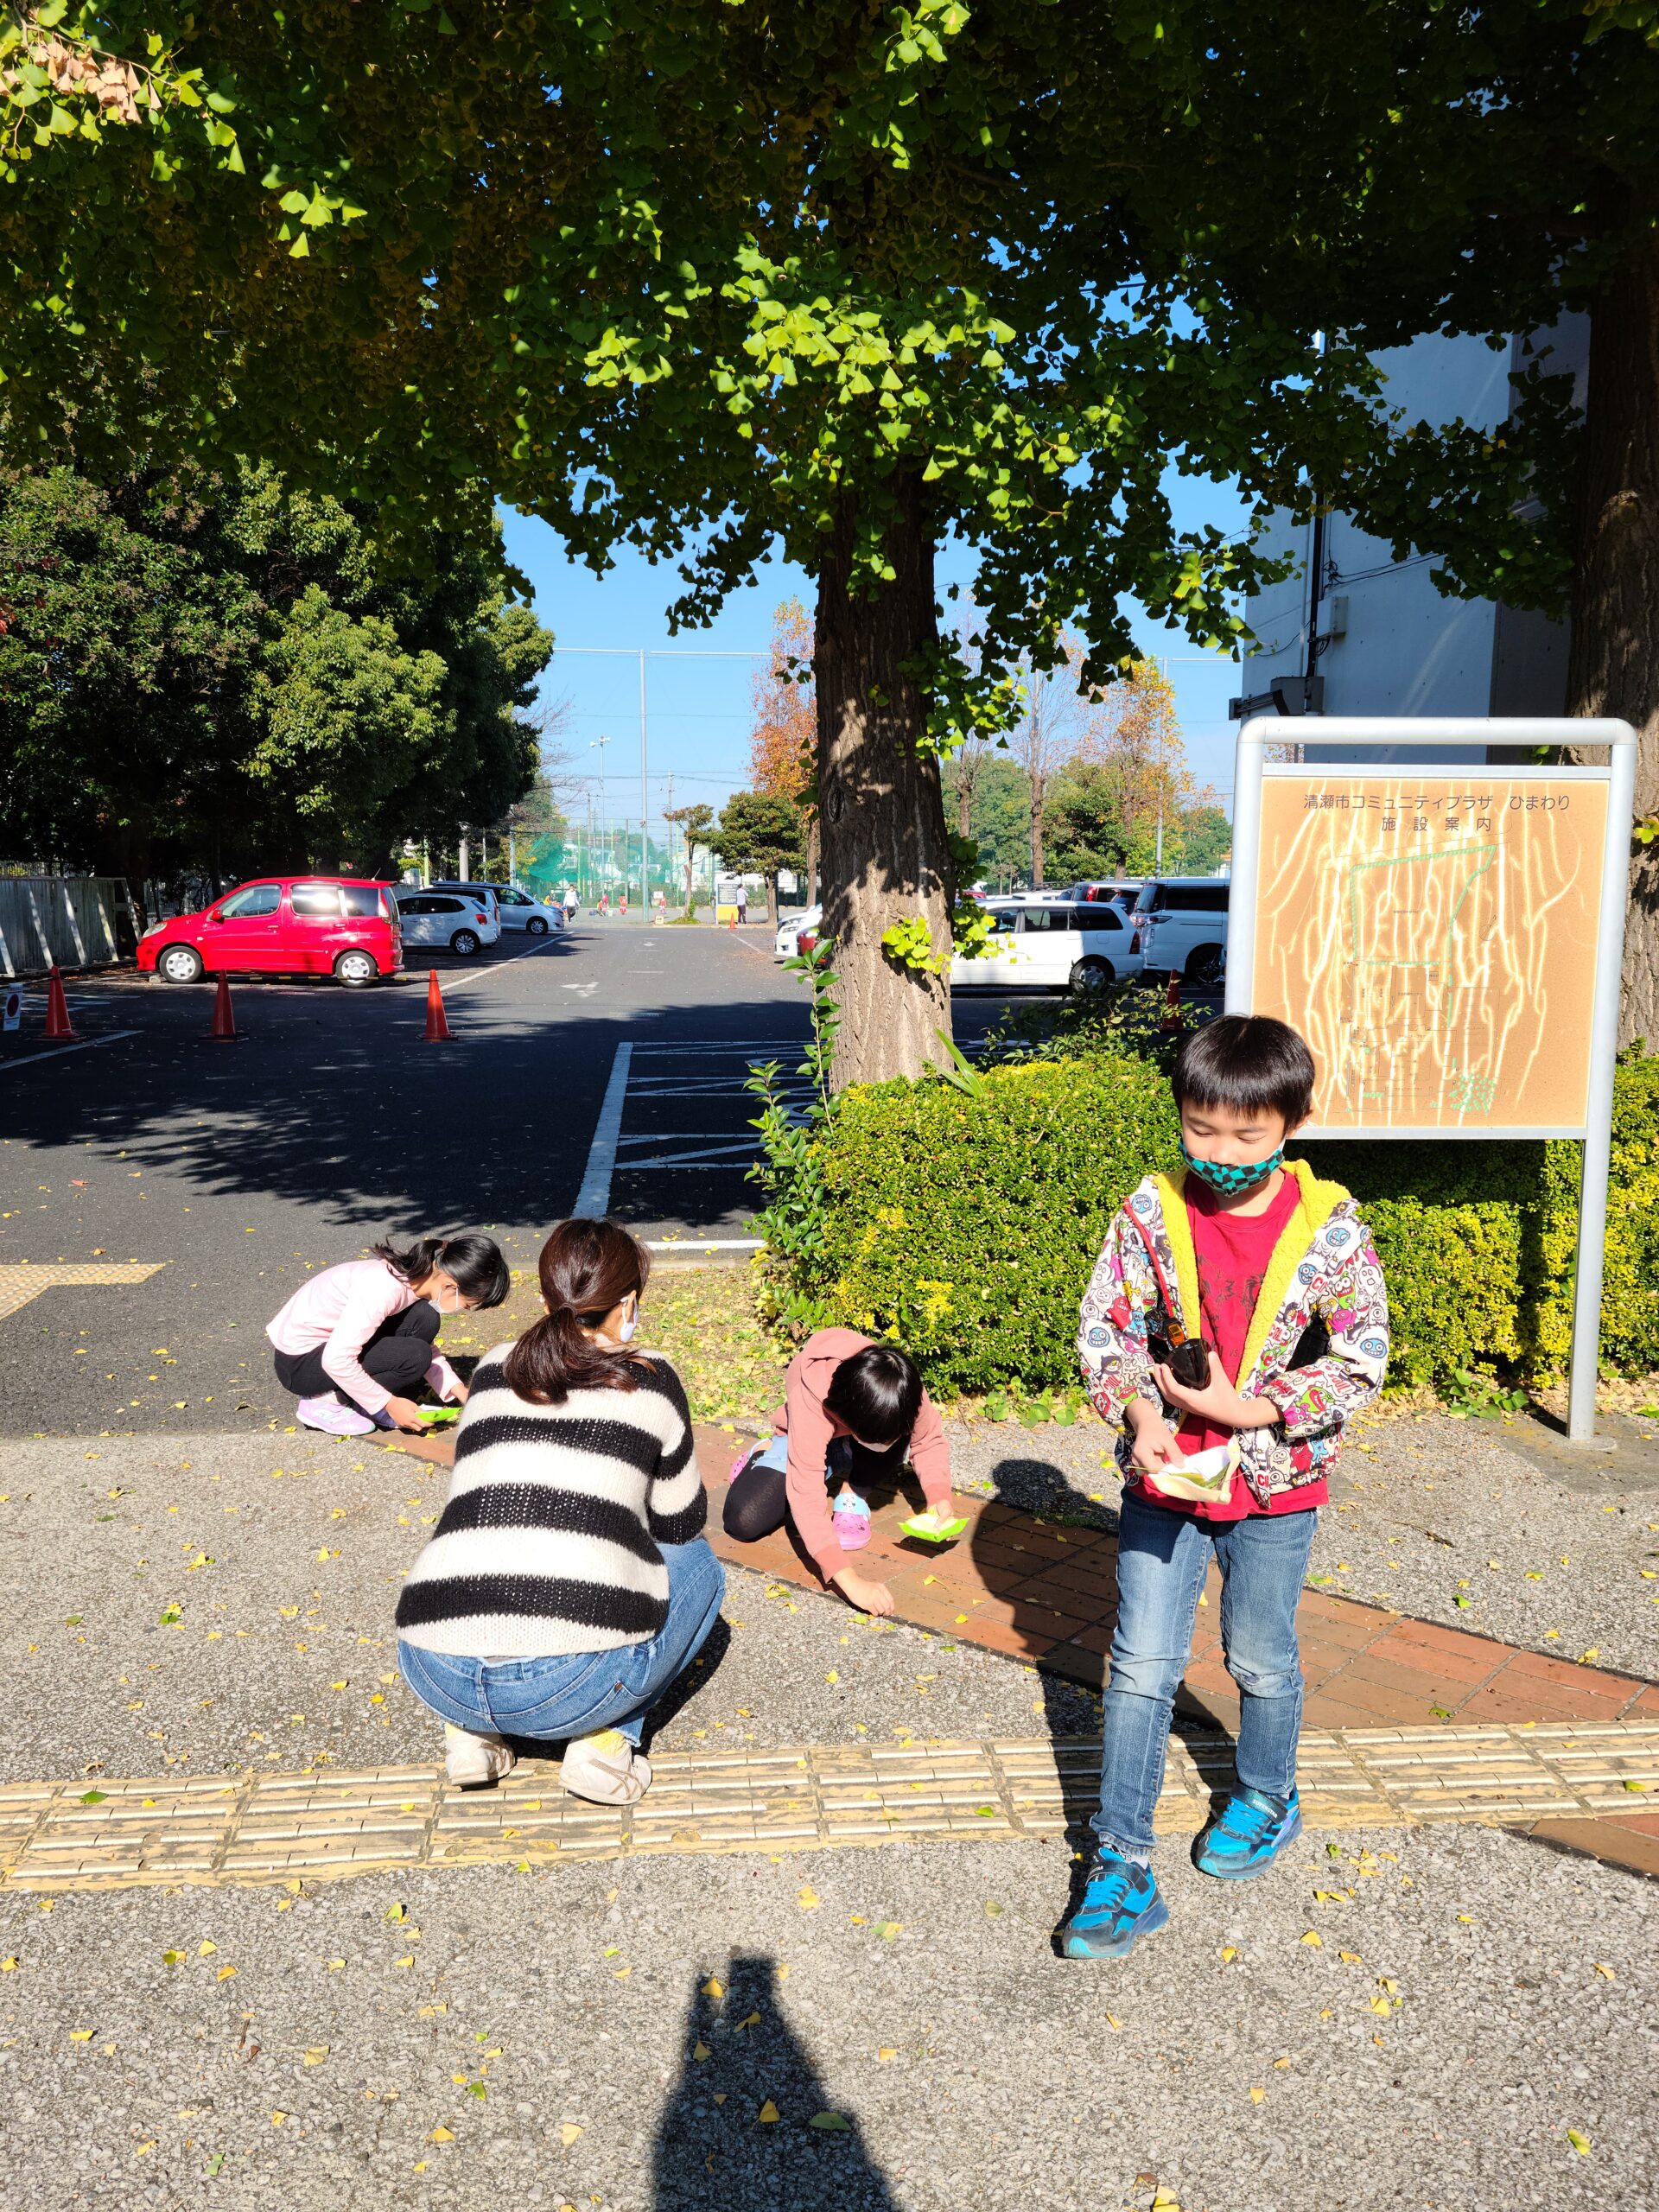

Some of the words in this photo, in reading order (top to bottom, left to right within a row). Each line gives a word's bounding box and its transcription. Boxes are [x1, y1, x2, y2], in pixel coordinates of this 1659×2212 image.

[1303, 794, 1493, 810] 清瀬市コミュニティプラザ
[1509, 794, 1570, 810] ひまわり
[1382, 817, 1491, 832] 施設案内
